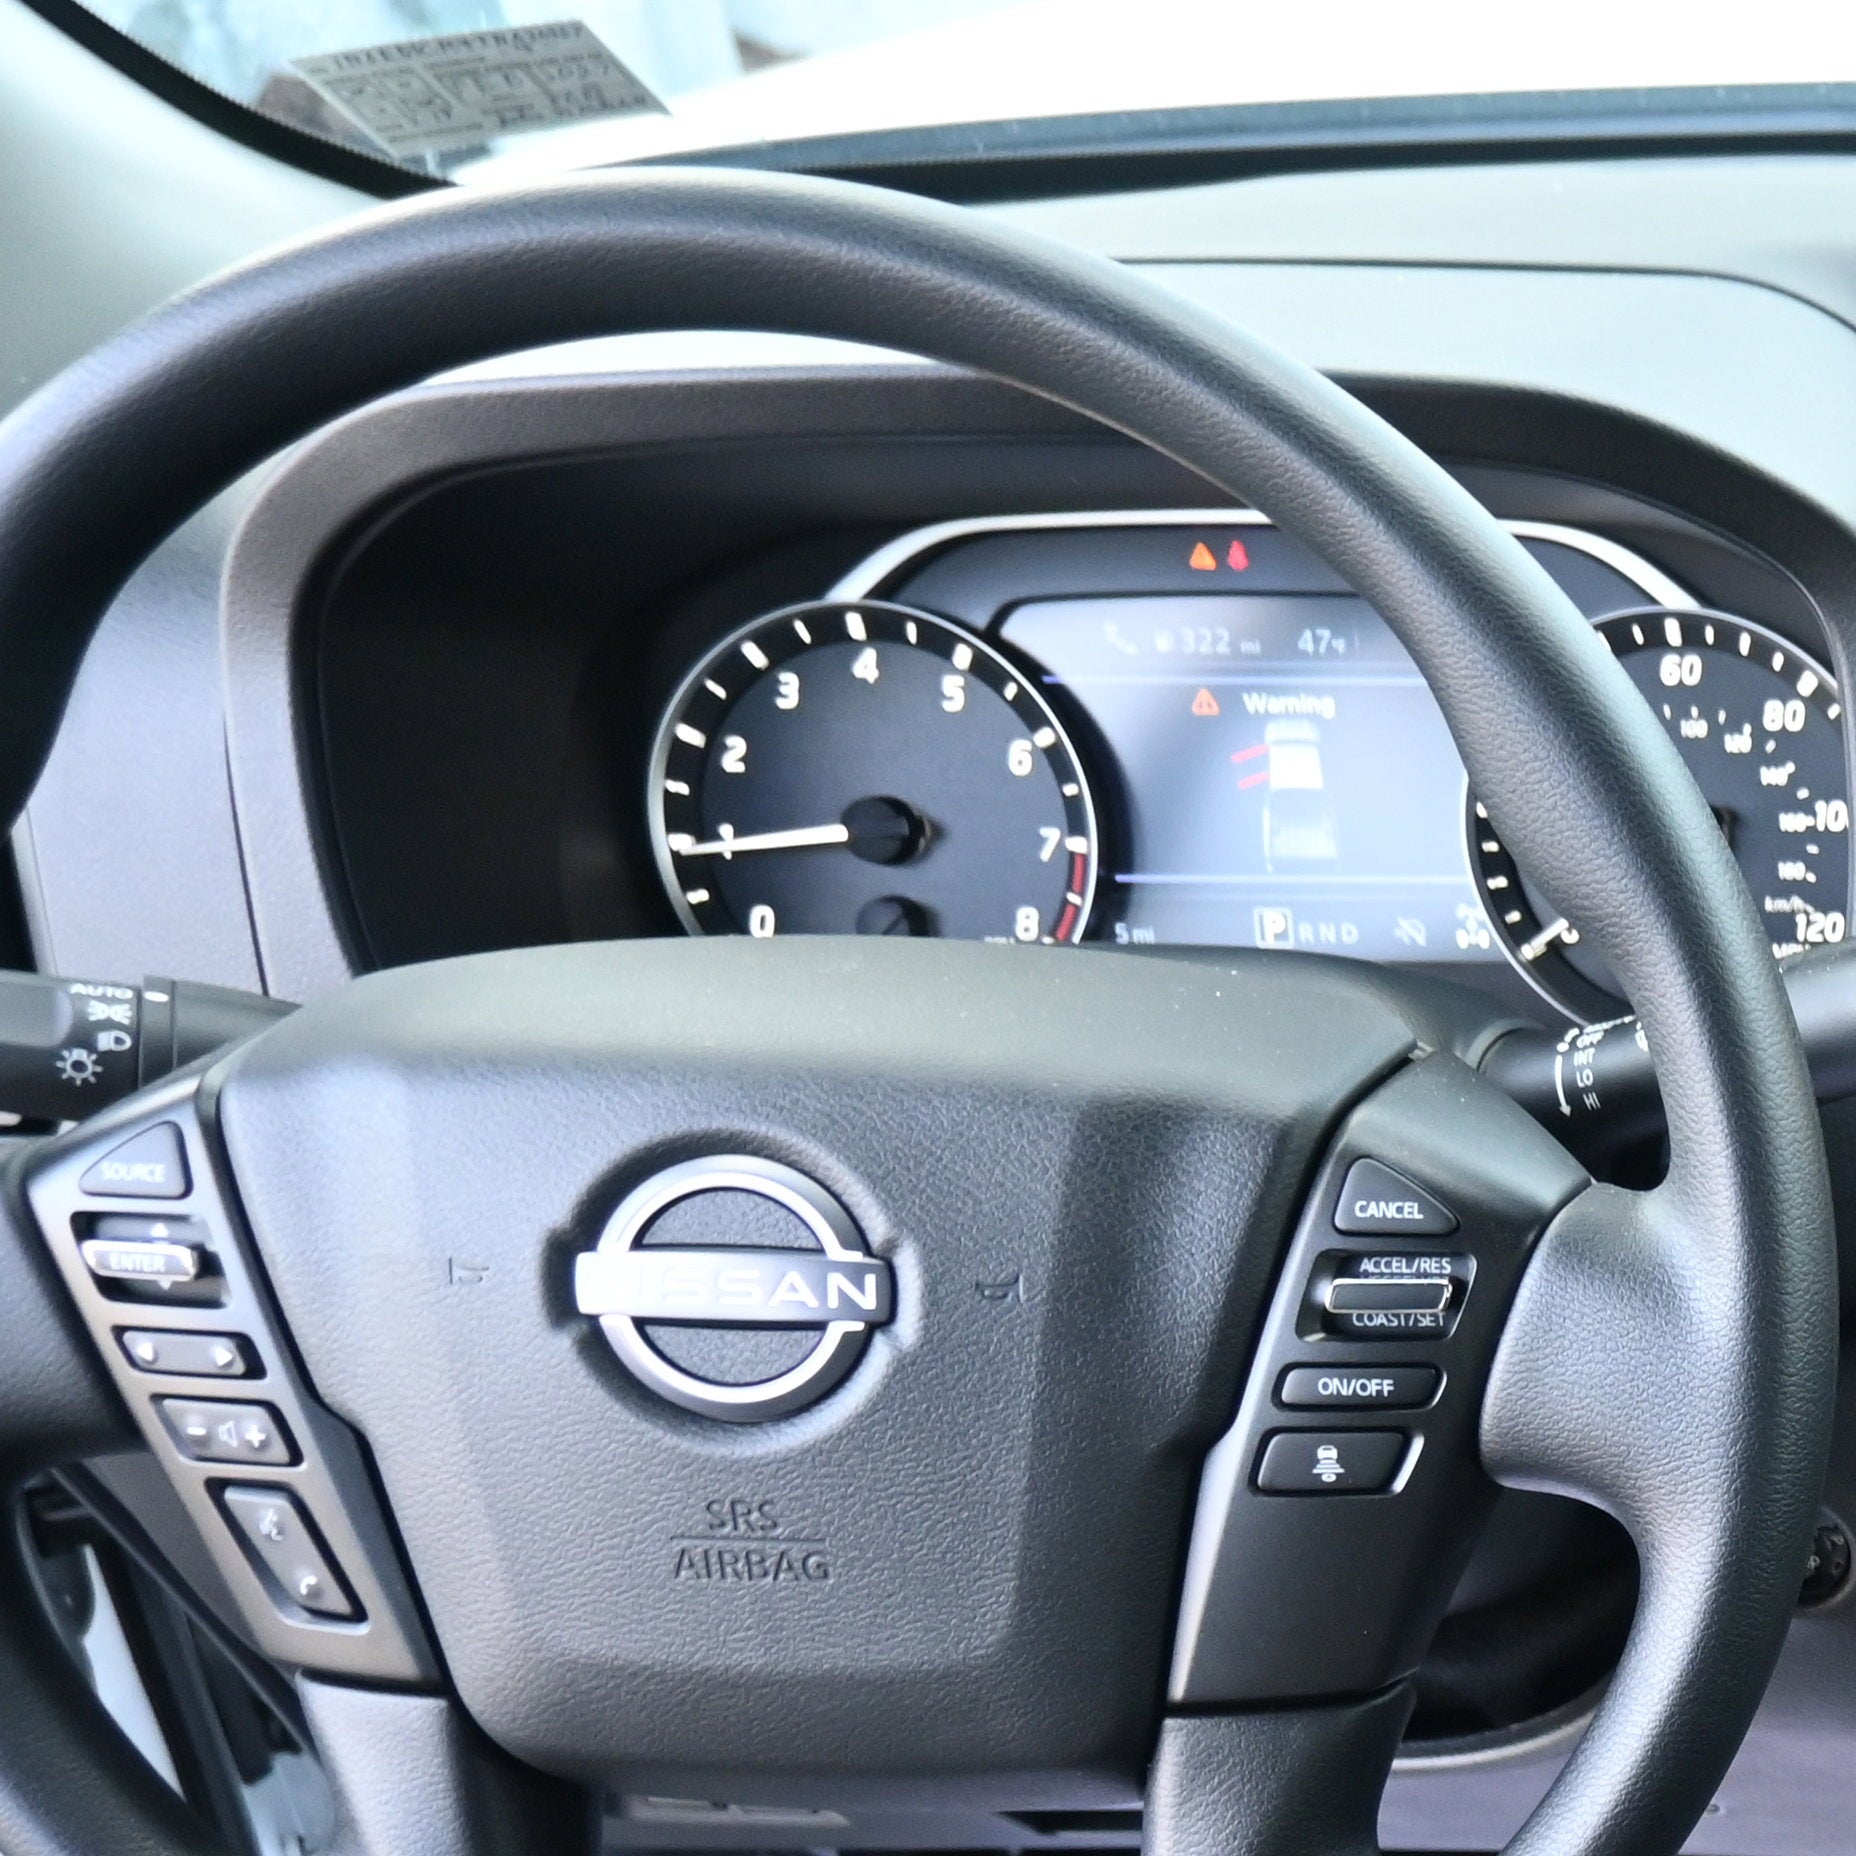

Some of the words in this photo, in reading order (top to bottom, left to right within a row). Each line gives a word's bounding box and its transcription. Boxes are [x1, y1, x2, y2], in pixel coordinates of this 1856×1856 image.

[1182, 628, 1231, 655] 322
[852, 648, 880, 684] 4
[1660, 654, 1703, 687] 60
[775, 672, 800, 710] 3
[942, 674, 966, 713] 5
[1243, 691, 1336, 719] Warning
[1762, 699, 1806, 733] 80
[721, 735, 747, 774] 2
[1007, 739, 1033, 777] 6
[1814, 799, 1849, 832] 10
[1038, 826, 1061, 863] 7
[749, 904, 776, 940] 0
[1014, 906, 1039, 942] 8
[1299, 923, 1315, 943] R
[1320, 923, 1337, 943] N
[1342, 922, 1359, 943] D
[1795, 911, 1845, 943] 120
[70, 983, 134, 1000] AUTO
[1573, 1047, 1596, 1067] INT
[1575, 1068, 1594, 1088] LO
[1582, 1091, 1602, 1111] HI
[101, 1163, 166, 1183] SOURCE
[1354, 1200, 1424, 1220] CANCEL
[109, 1253, 166, 1273] ENTER
[1359, 1256, 1451, 1274] ACCEL/RES
[1352, 1312, 1446, 1327] COAST/SET
[1317, 1377, 1395, 1397] ON/OFF
[705, 1500, 779, 1531] SRS
[673, 1548, 829, 1582] AIRBAG
